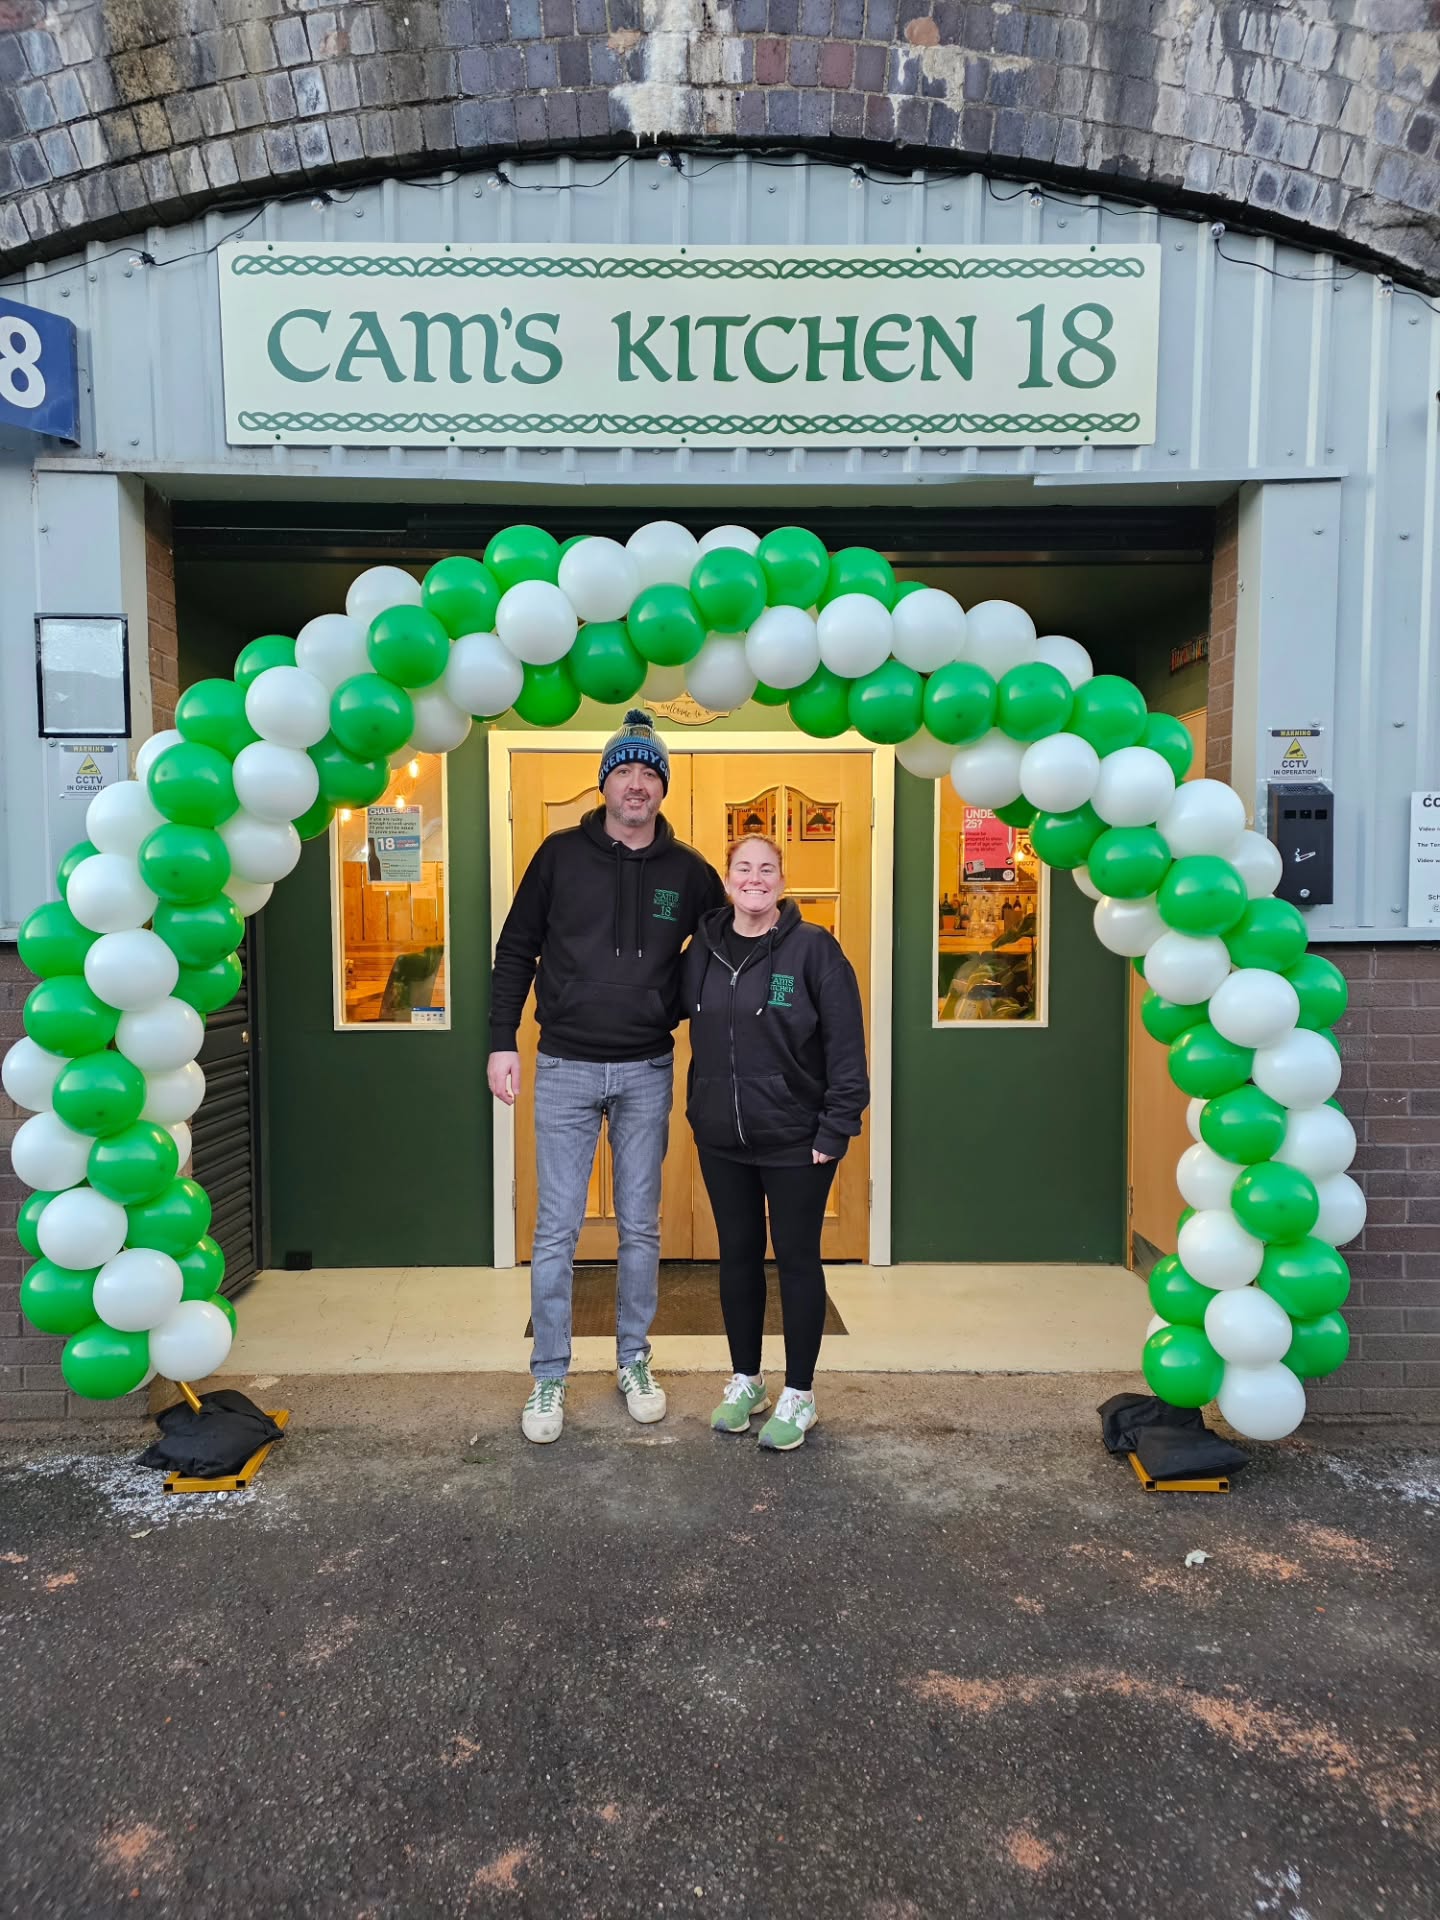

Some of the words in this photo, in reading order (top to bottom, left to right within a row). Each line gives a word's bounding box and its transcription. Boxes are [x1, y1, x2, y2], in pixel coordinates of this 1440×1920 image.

[267, 306, 563, 385] CAM'S
[611, 310, 977, 383] KITCHEN
[1016, 302, 1117, 389] 18
[599, 747, 659, 780] OVENTRY
[1281, 760, 1309, 768] CCTV
[75, 775, 103, 784] CCTV
[966, 809, 997, 819] UNDE
[966, 819, 983, 828] 25?
[377, 838, 396, 850] 18
[661, 905, 672, 917] 18
[770, 984, 794, 993] ITCHEN
[772, 991, 785, 1002] 18
